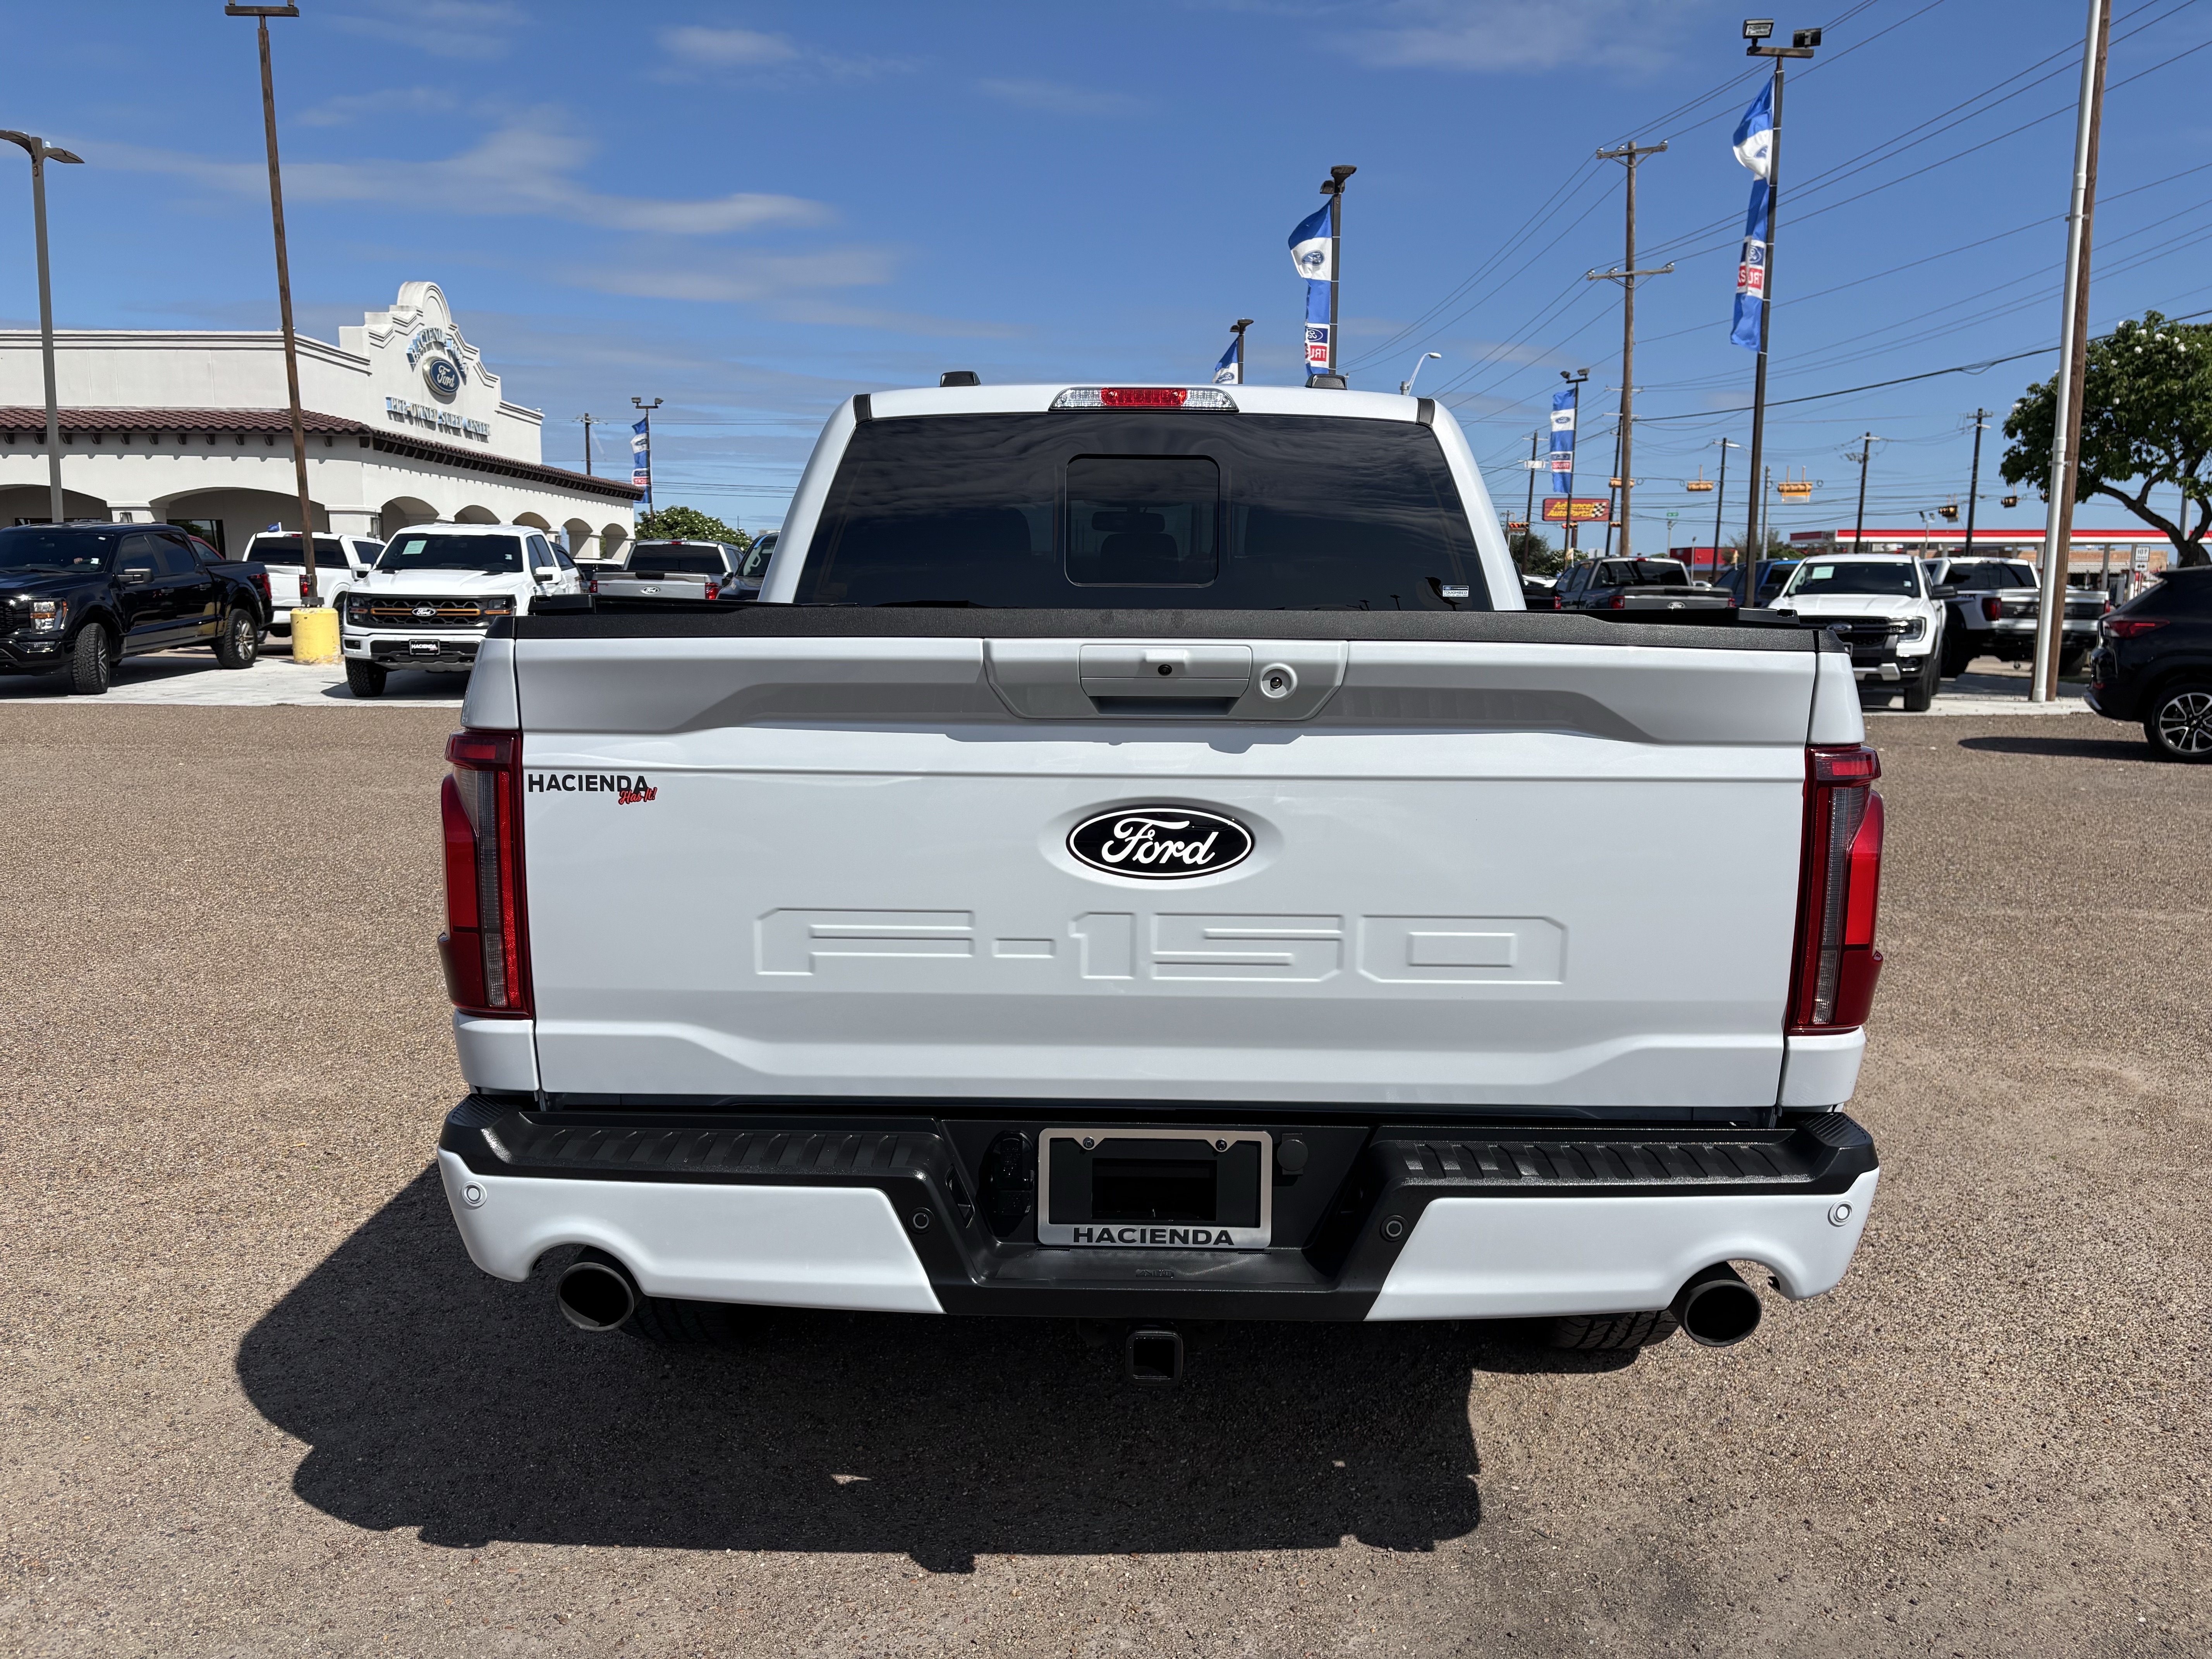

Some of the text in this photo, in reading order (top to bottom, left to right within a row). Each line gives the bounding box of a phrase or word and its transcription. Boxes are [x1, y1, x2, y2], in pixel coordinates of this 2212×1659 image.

[437, 365, 455, 387] Ford
[387, 397, 438, 422] PRE-OWNED
[441, 411, 463, 429] SUPER
[528, 774, 648, 793] HACIENDA
[618, 787, 658, 805] Has It!
[1101, 817, 1219, 864] Ford
[755, 908, 1568, 984] F-150
[1073, 1227, 1235, 1246] HACIENDA
